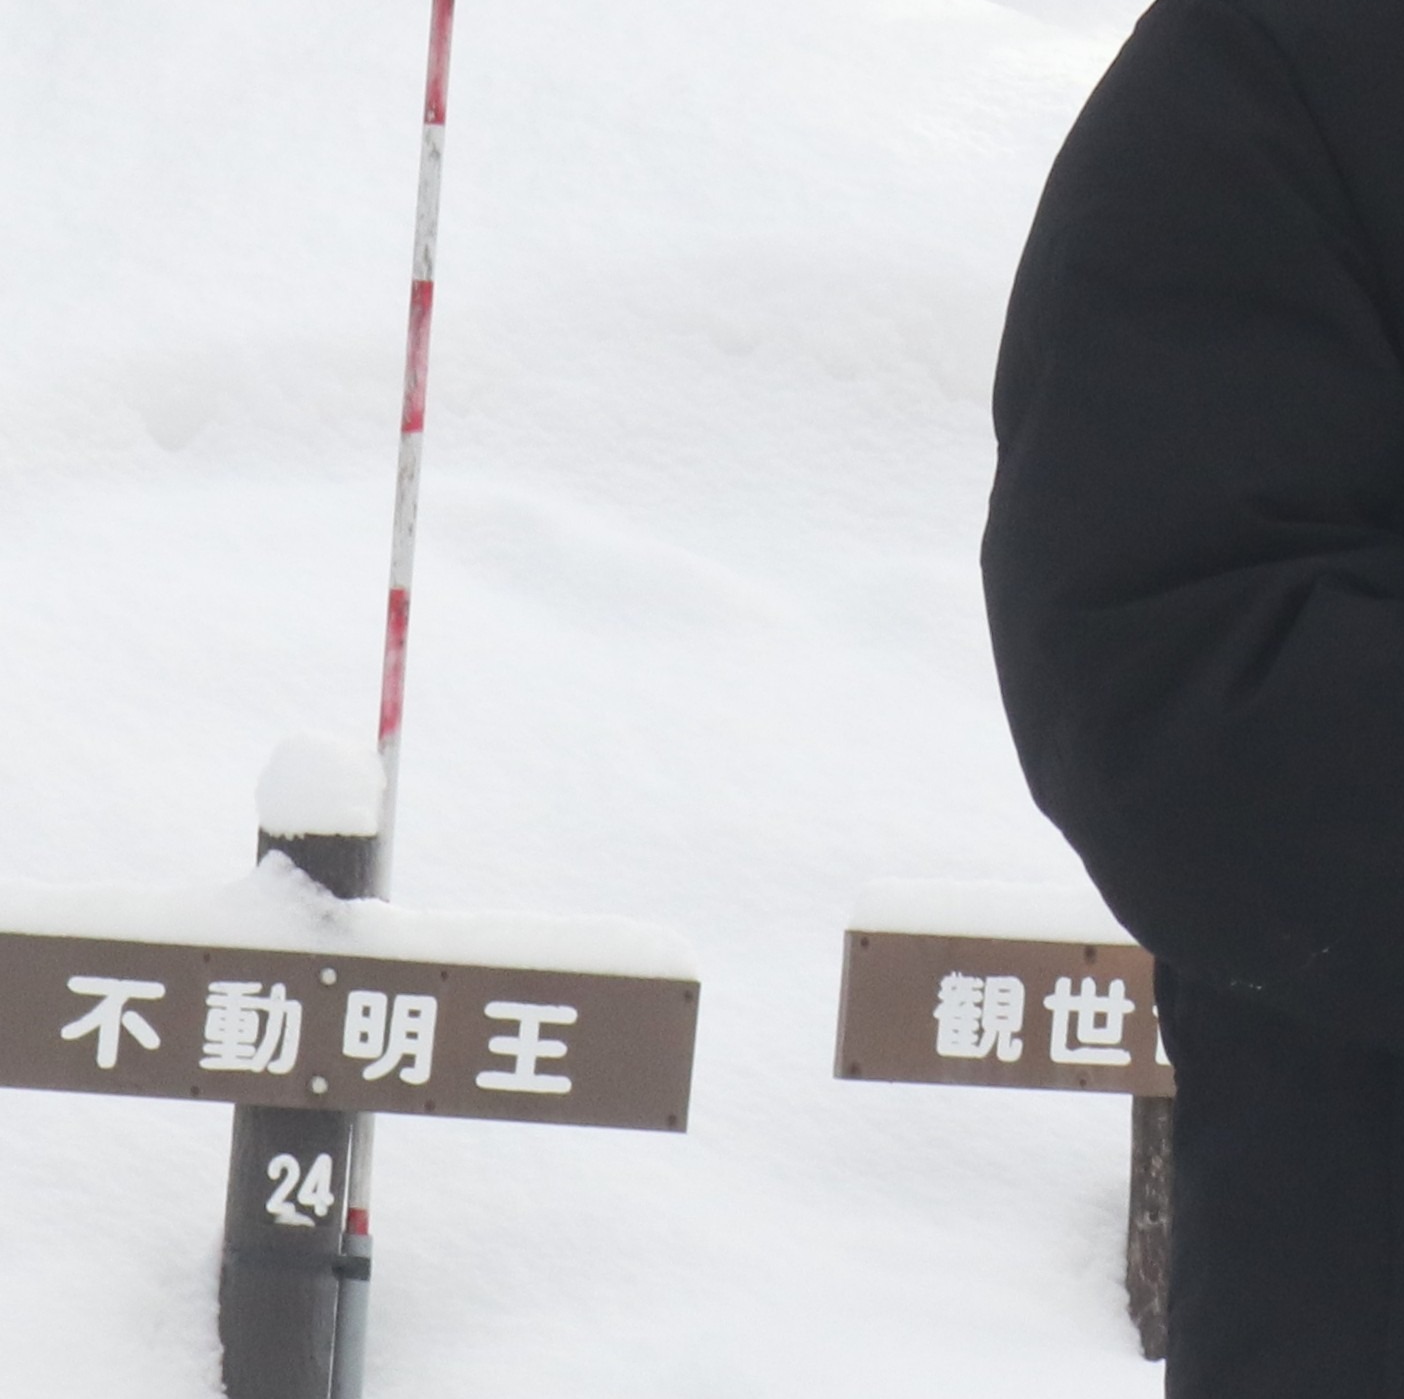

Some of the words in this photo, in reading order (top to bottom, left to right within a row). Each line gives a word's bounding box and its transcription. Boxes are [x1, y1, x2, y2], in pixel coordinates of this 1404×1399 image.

[61, 975, 578, 1093] 不動明王
[933, 971, 1173, 1067] 観世
[266, 1153, 335, 1218] 24
